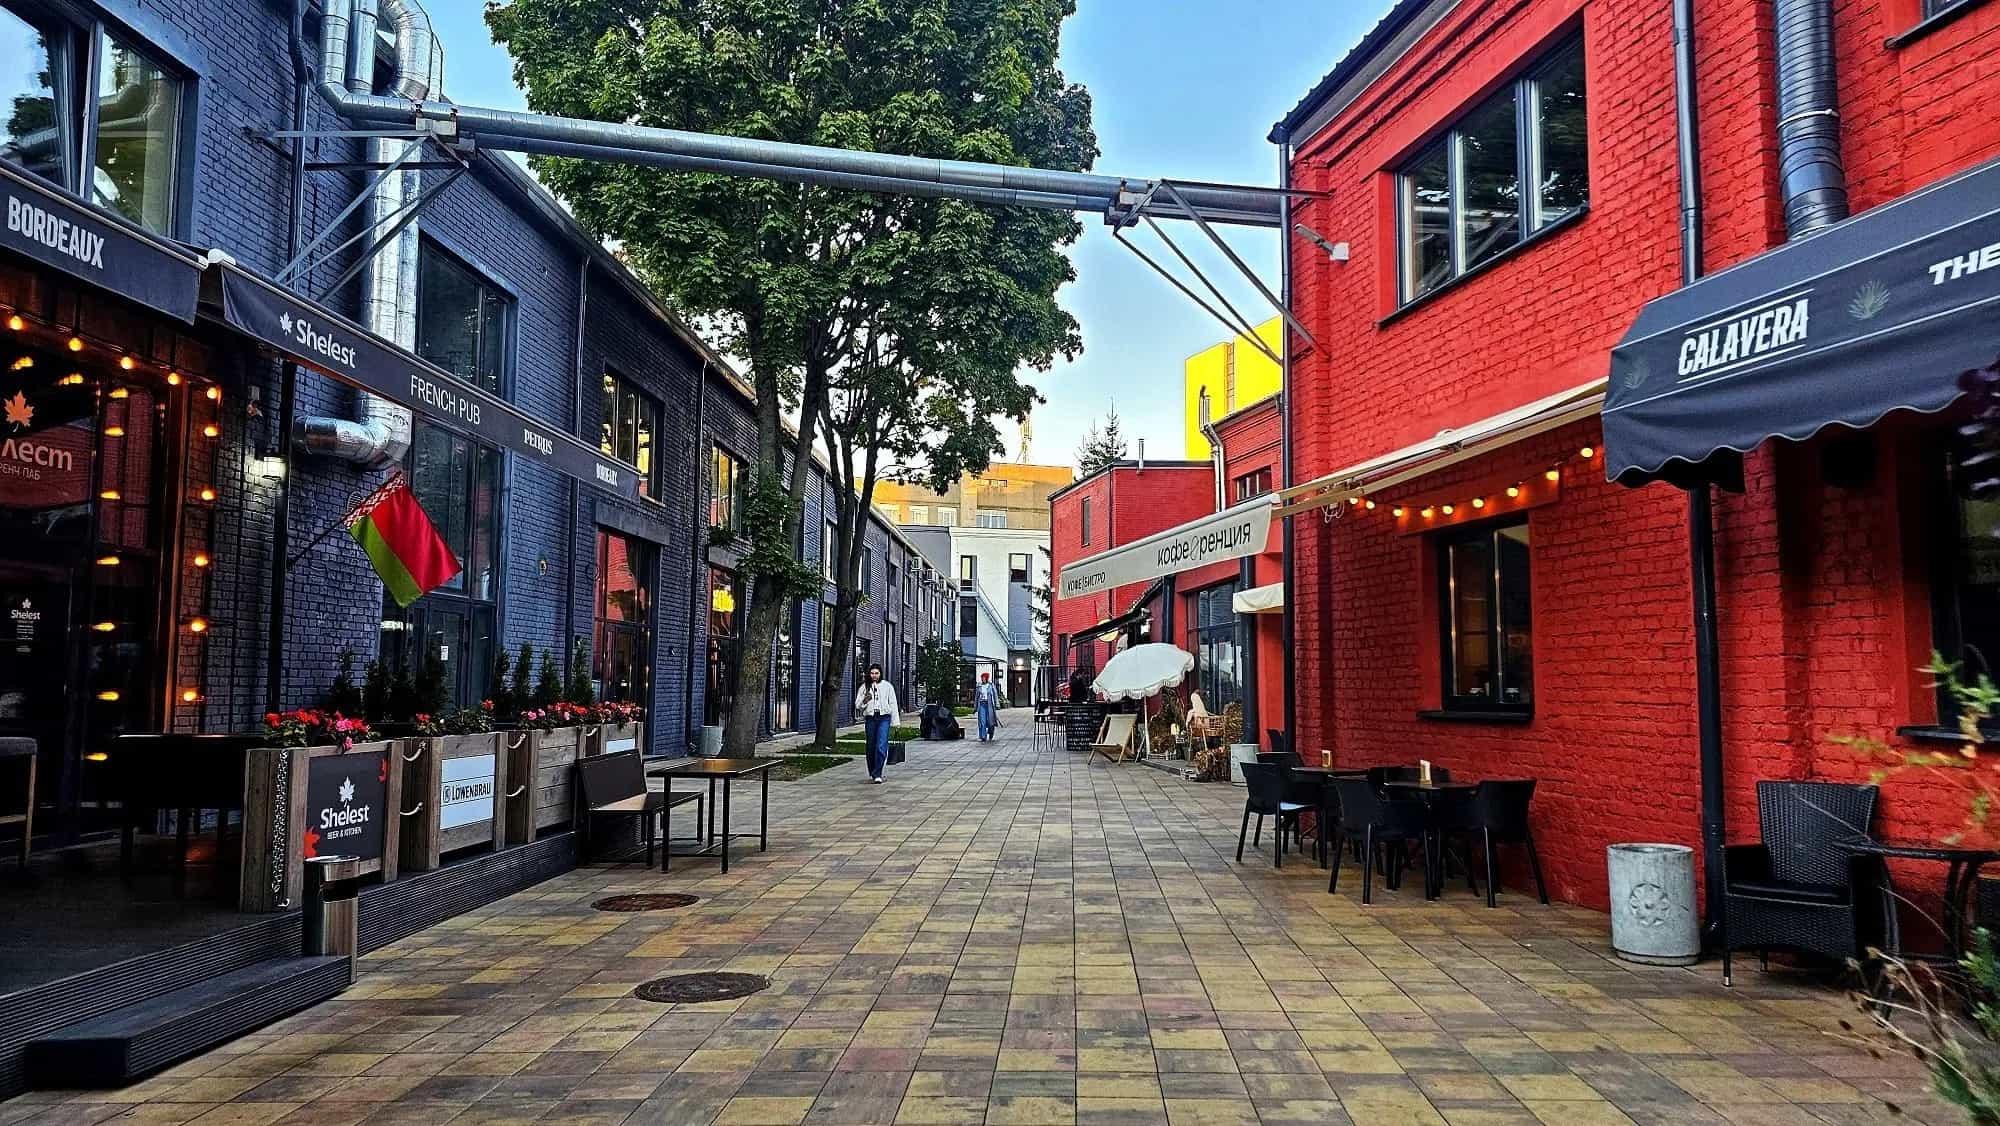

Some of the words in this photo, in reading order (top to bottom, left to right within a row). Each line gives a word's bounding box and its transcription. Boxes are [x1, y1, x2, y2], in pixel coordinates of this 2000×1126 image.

[7, 194, 105, 270] BORDEAUX
[1928, 242, 2000, 286] THE
[296, 318, 357, 369] Shelest
[1677, 298, 1809, 376] CALAVERA
[410, 374, 456, 416] FRENCH
[459, 397, 481, 425] PUB
[523, 428, 553, 456] PETRUS
[10, 609, 41, 621] Shelest
[320, 804, 370, 830] Shelest
